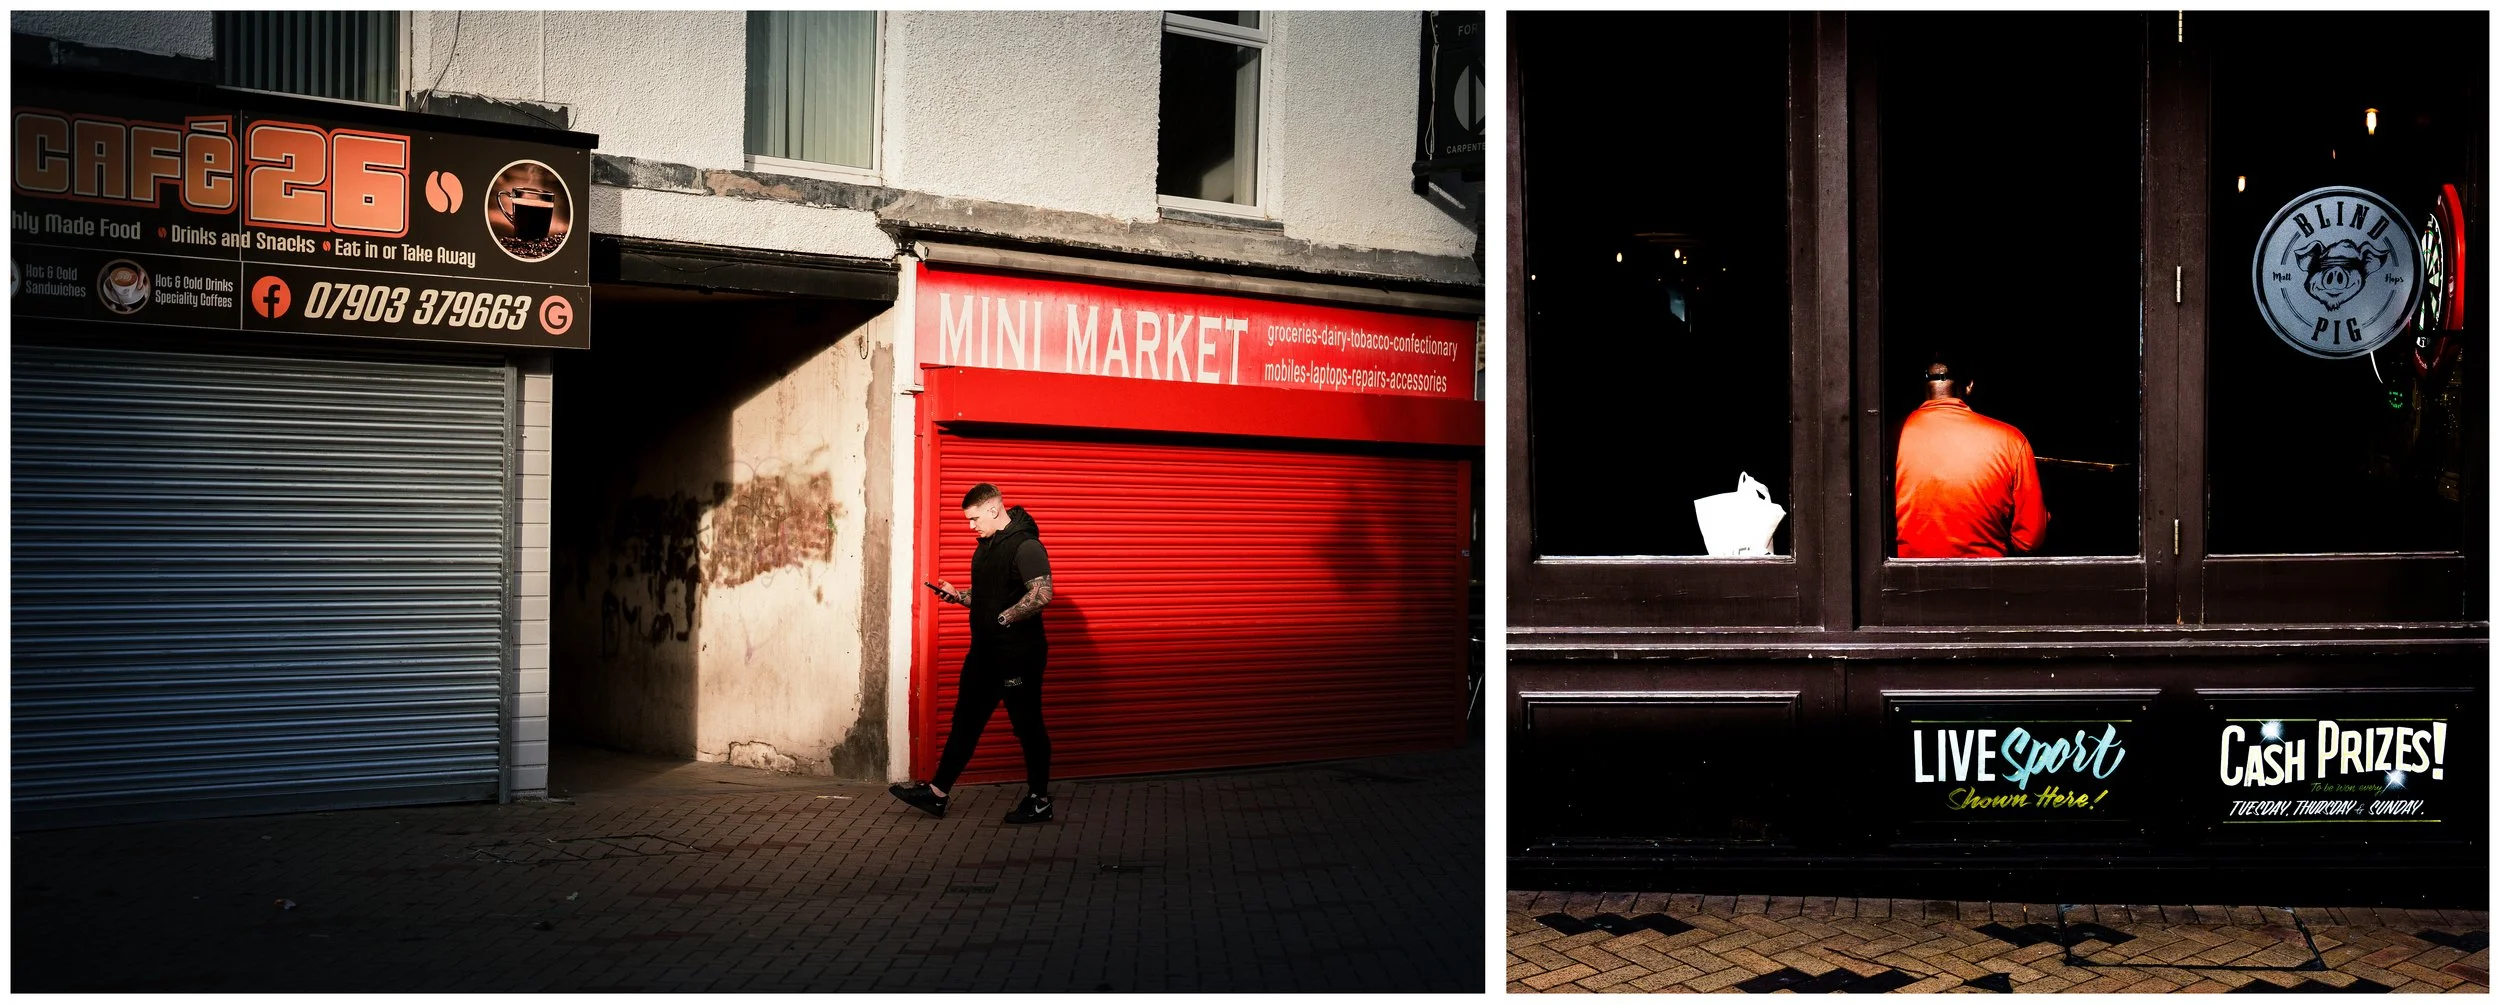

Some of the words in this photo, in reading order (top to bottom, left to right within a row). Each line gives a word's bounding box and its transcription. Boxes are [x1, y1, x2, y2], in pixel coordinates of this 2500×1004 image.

[245, 120, 410, 238] 26
[45, 213, 95, 236] Made
[100, 217, 141, 240] Food
[2293, 201, 2389, 240] BLIND
[171, 224, 217, 246] Drinks
[221, 230, 251, 248] and
[256, 232, 316, 253] Snacks
[334, 239, 361, 257] Eat
[365, 241, 378, 258] in
[382, 245, 397, 260] or
[401, 244, 433, 262] Take
[437, 247, 476, 268] Away
[25, 264, 45, 279] Hot
[56, 266, 78, 281] Cold
[155, 274, 173, 287] Hot
[183, 275, 203, 291] Cold
[205, 278, 233, 292] Drinks
[25, 280, 87, 298] Sandwiches
[155, 289, 198, 308] Speciality
[200, 293, 232, 308] Coffees
[303, 281, 410, 324] 07903
[412, 289, 532, 331] 379663
[938, 293, 1043, 371] MINI
[1065, 303, 1249, 385] MARKET
[1267, 323, 1458, 362] groceries-dairy-tobacco-confectionary
[2311, 317, 2362, 345] PIG
[1264, 358, 1447, 393] mobiles-laptops-repairs-accessories
[1914, 729, 1997, 783] LIVE
[2001, 722, 2126, 790] Sport
[2220, 724, 2306, 787] CASH
[2317, 720, 2447, 780] PRIZES!
[1946, 786, 2032, 810] Shown
[2034, 785, 2109, 810] Here!
[2310, 782, 2322, 792] To
[2323, 783, 2334, 792] be
[2359, 783, 2383, 797] every
[2293, 800, 2357, 816] THURSDAY
